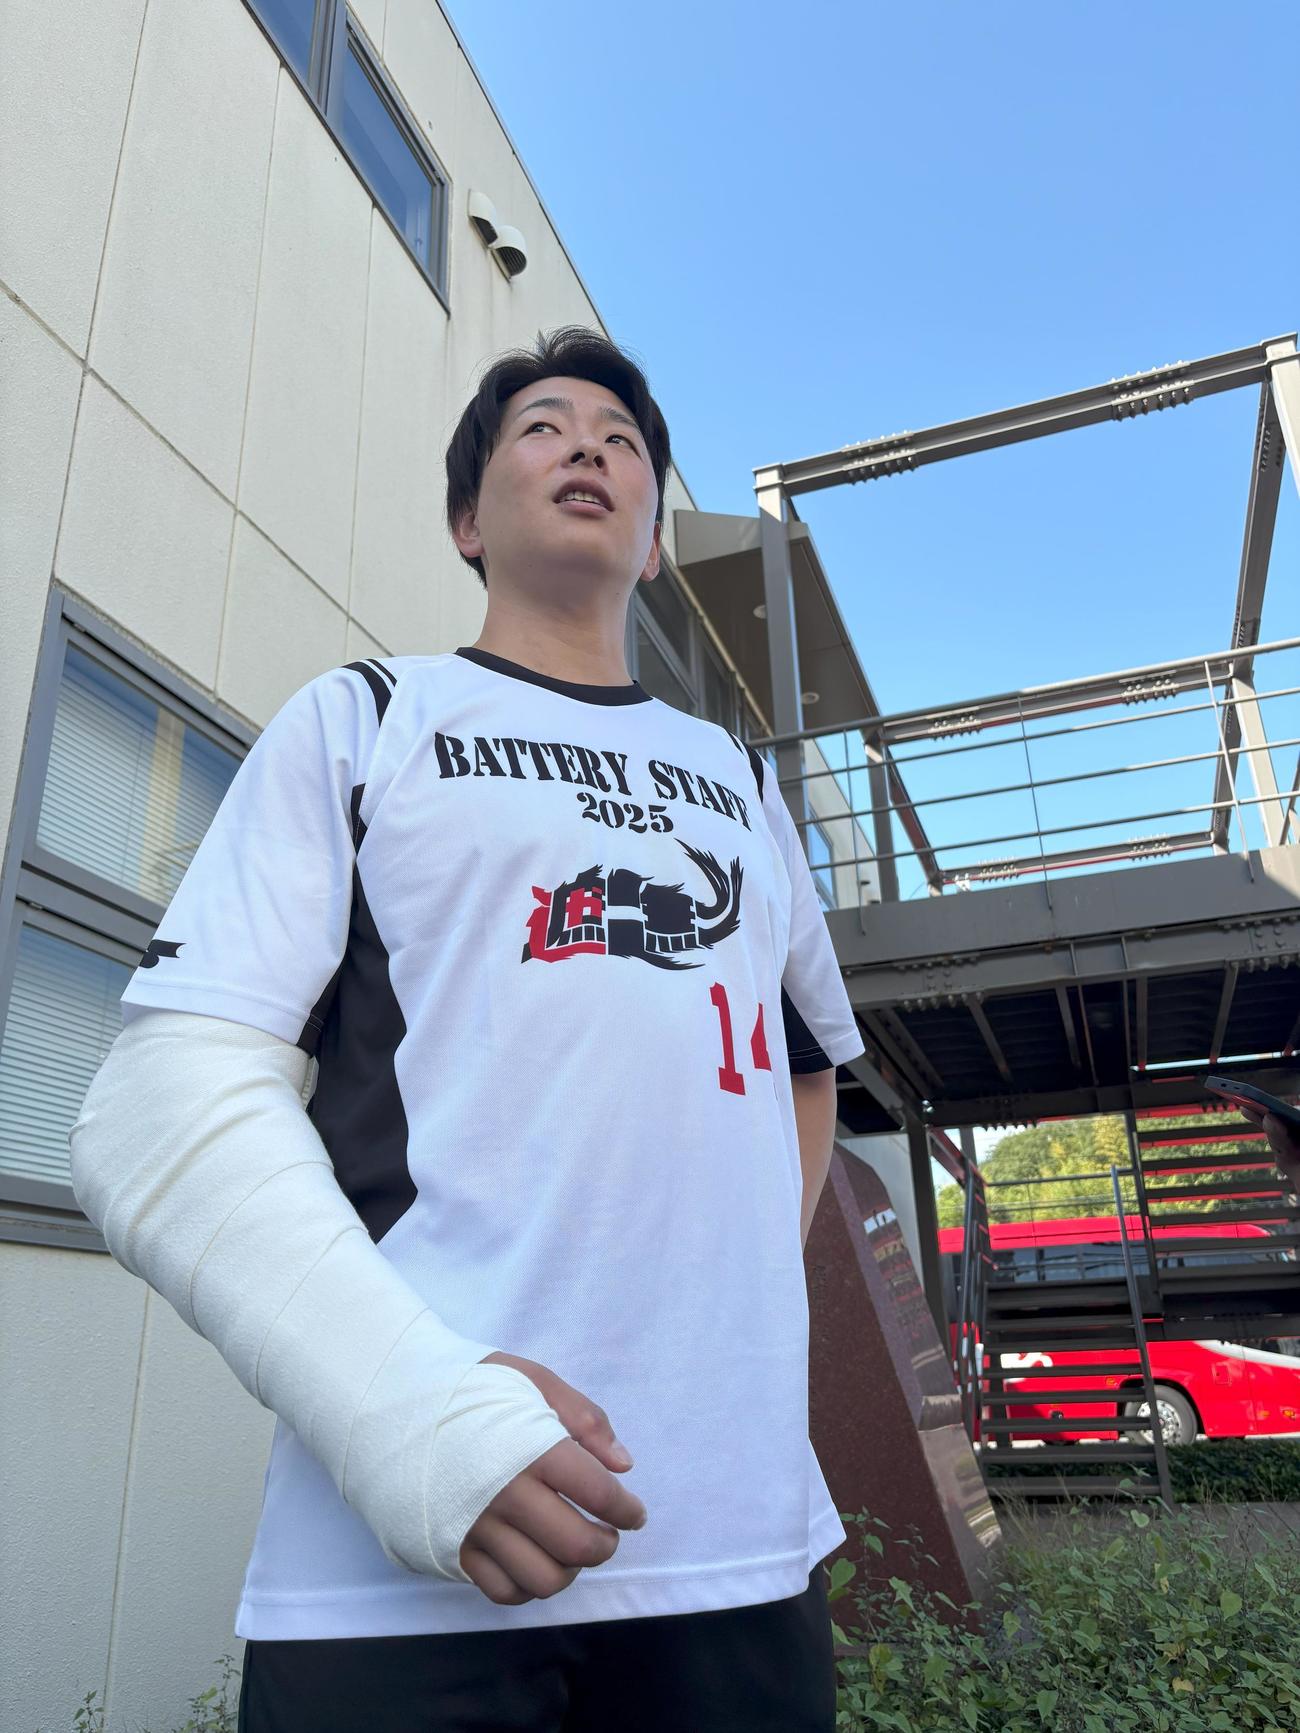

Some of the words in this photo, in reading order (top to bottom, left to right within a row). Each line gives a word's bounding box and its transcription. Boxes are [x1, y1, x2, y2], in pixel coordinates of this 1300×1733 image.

[434, 731, 632, 796] BATTERY
[648, 759, 752, 832] STAFF
[576, 792, 674, 834] 2025
